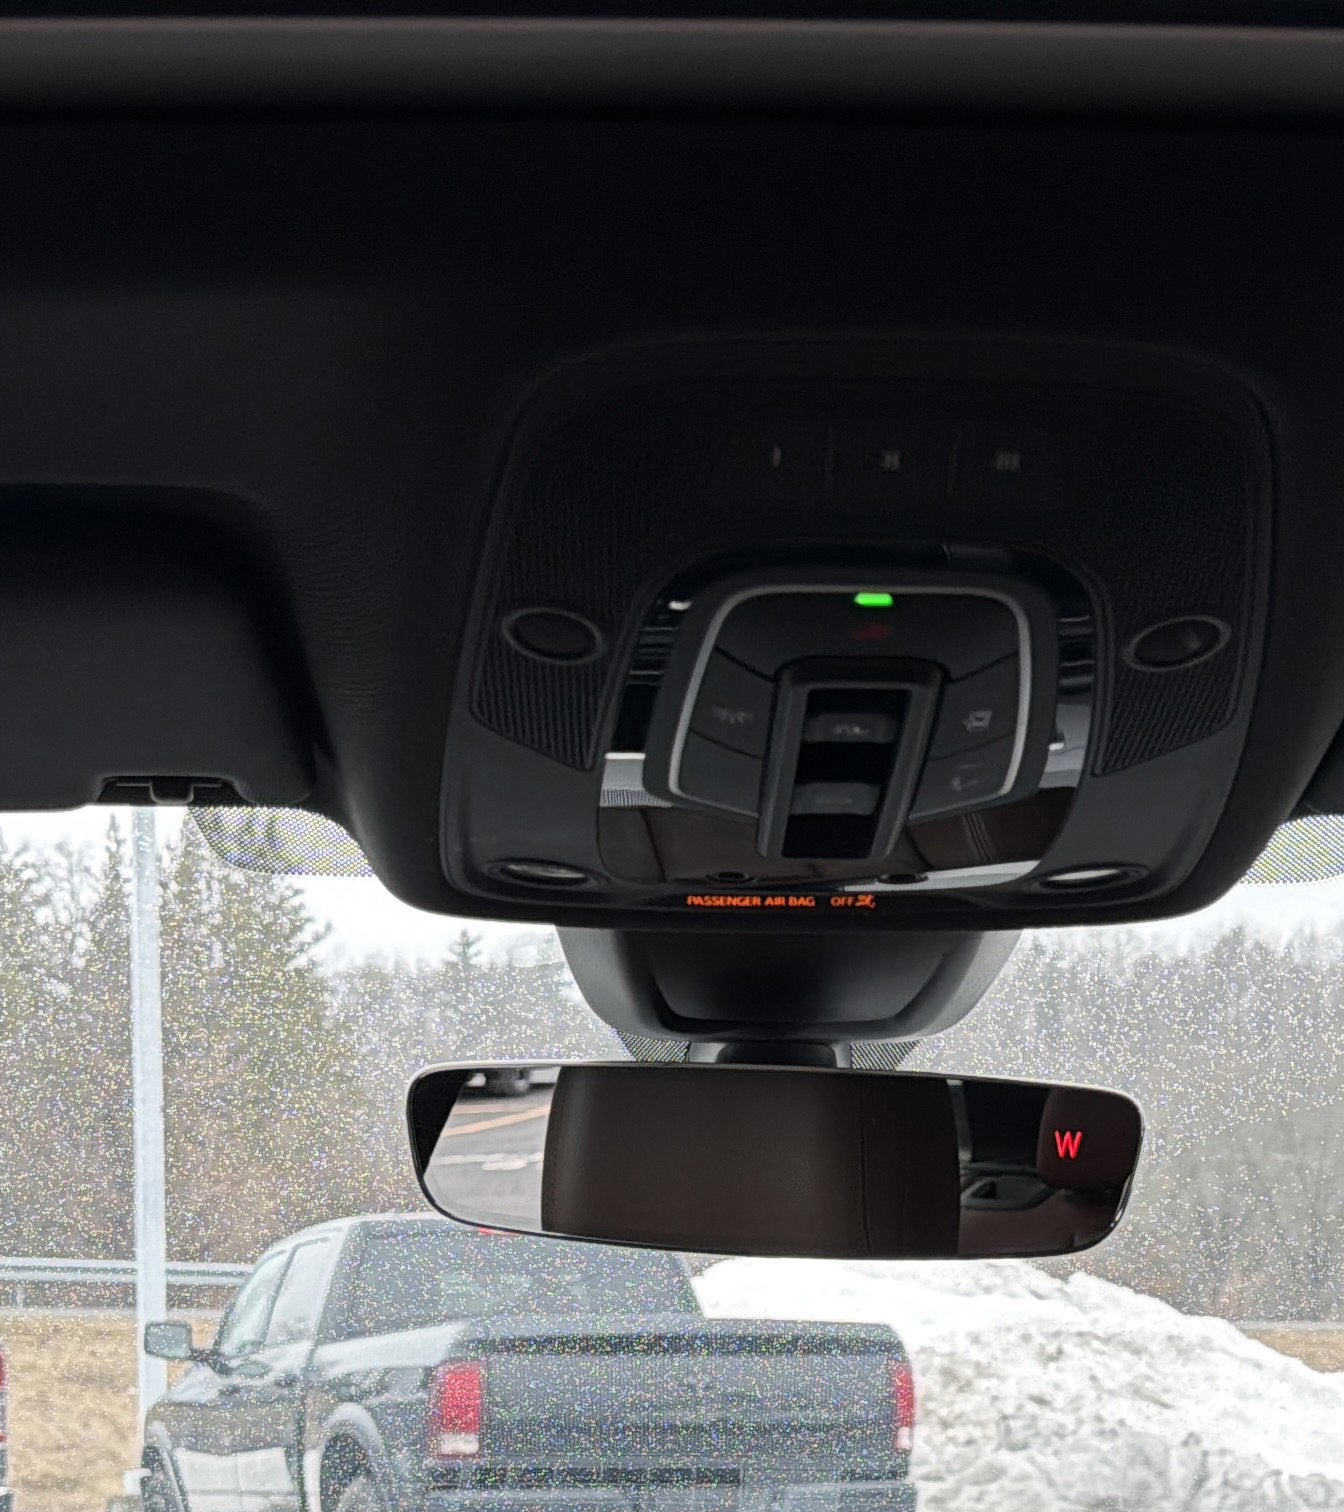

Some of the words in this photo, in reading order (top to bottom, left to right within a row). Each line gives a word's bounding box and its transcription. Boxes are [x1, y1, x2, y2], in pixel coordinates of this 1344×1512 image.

[687, 896, 761, 907] PASSENGER
[764, 896, 786, 907] AIR
[788, 896, 815, 907] BAG
[830, 896, 856, 907] OFF
[1057, 1131, 1083, 1158] W
